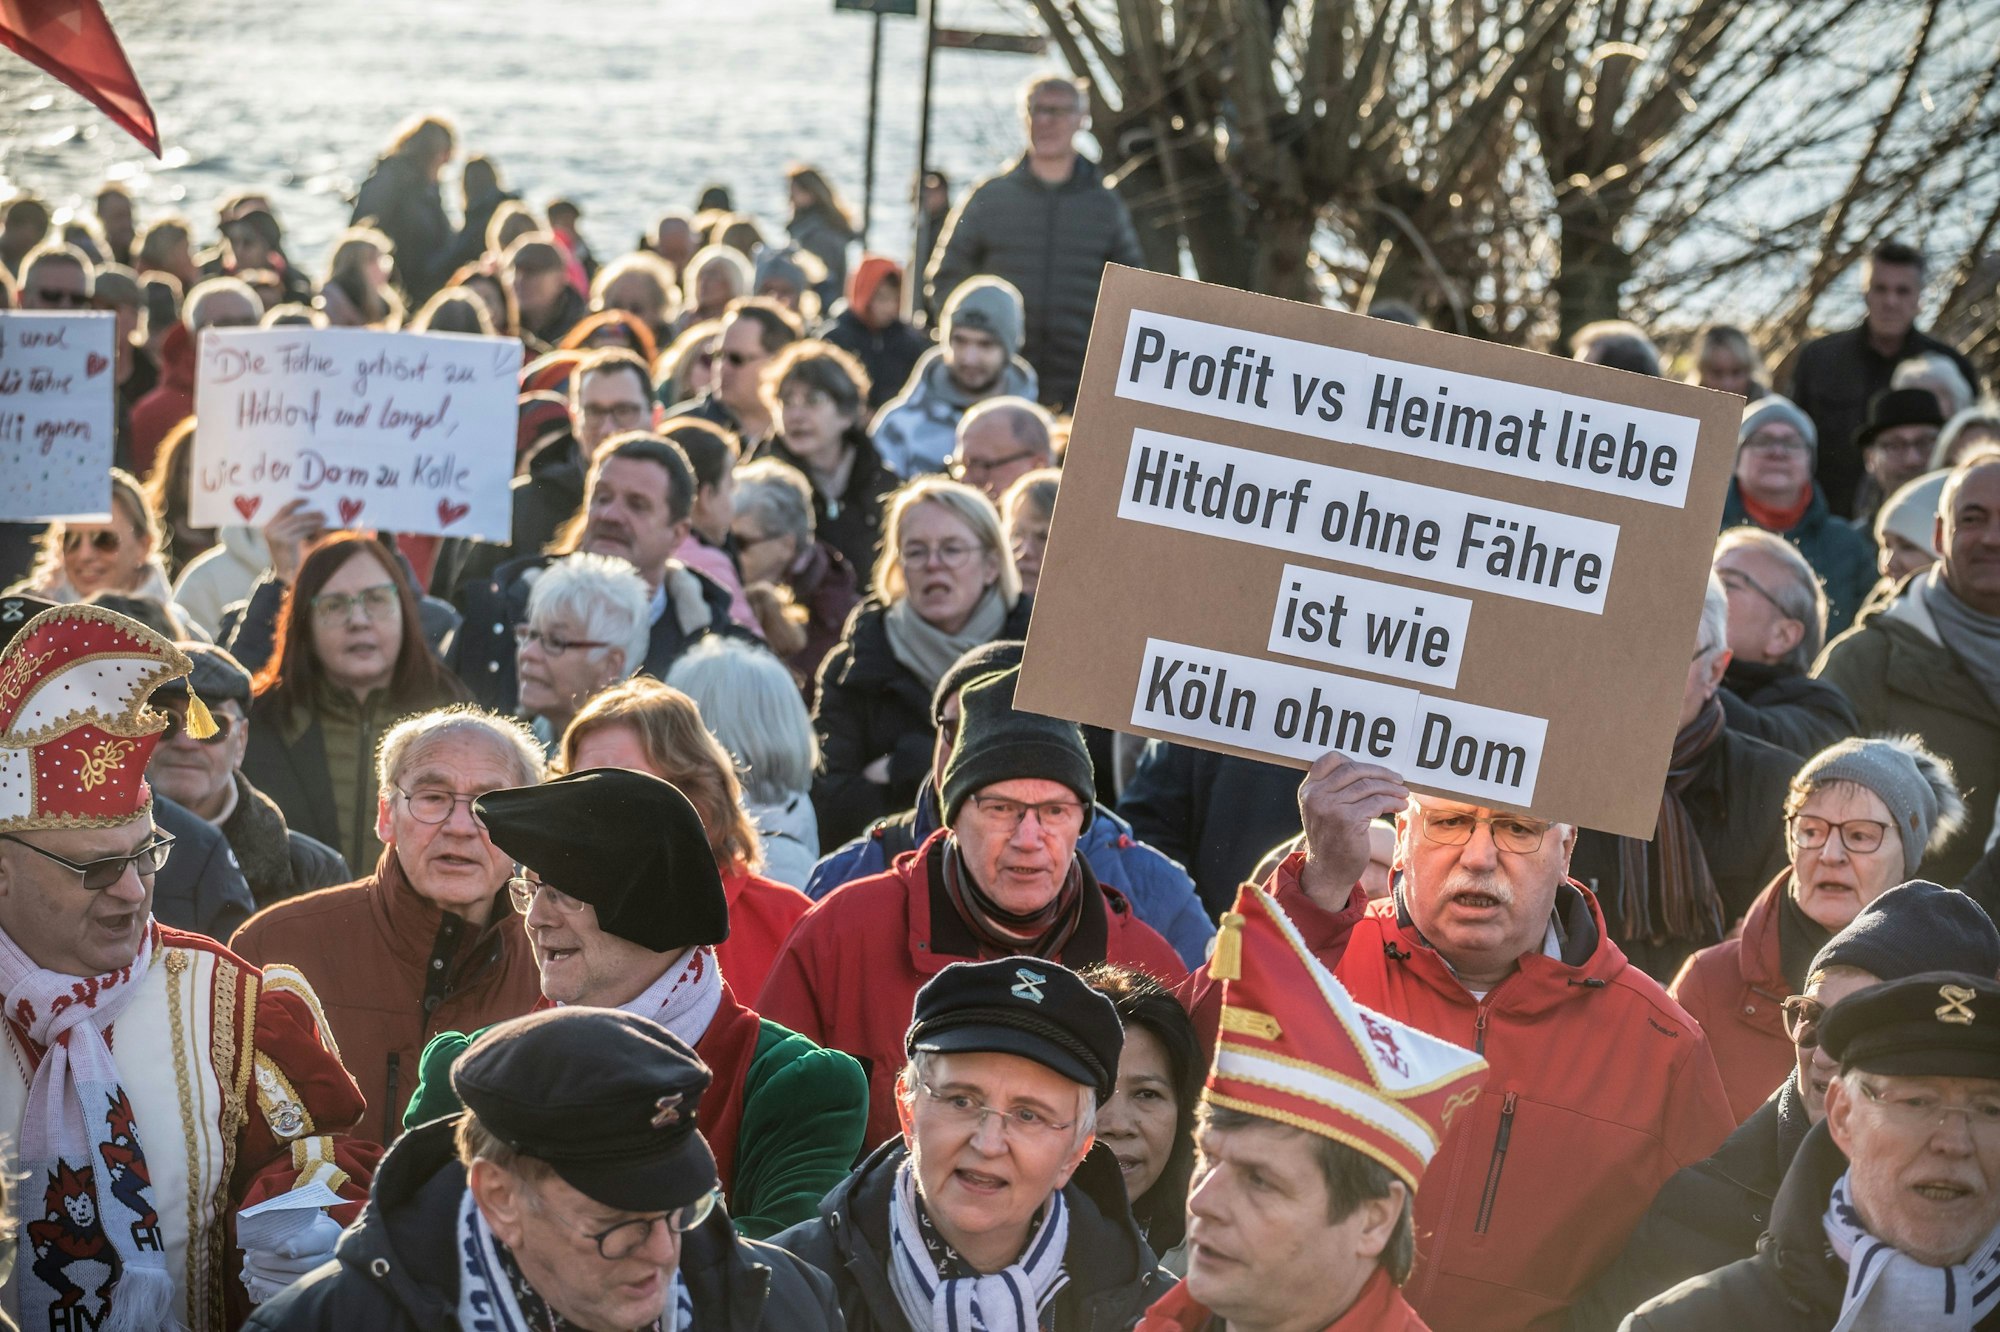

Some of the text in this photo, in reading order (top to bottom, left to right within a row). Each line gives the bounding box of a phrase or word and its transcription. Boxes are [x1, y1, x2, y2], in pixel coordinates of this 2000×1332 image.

[20, 326, 70, 349] und
[212, 348, 272, 383] Die
[353, 350, 433, 397] gehört
[1130, 327, 1274, 408] Profit
[1293, 374, 1345, 422] vs
[238, 389, 320, 435] Hitdorf
[335, 403, 371, 427] und
[202, 460, 245, 492] wie
[252, 452, 294, 482] der
[297, 451, 369, 492] Dom
[376, 464, 399, 488] zu
[1131, 447, 1602, 595] Hitdorf ohne Fähre
[1283, 582, 1450, 668] ist wie
[1145, 656, 1526, 788] Köln ohne Dom
